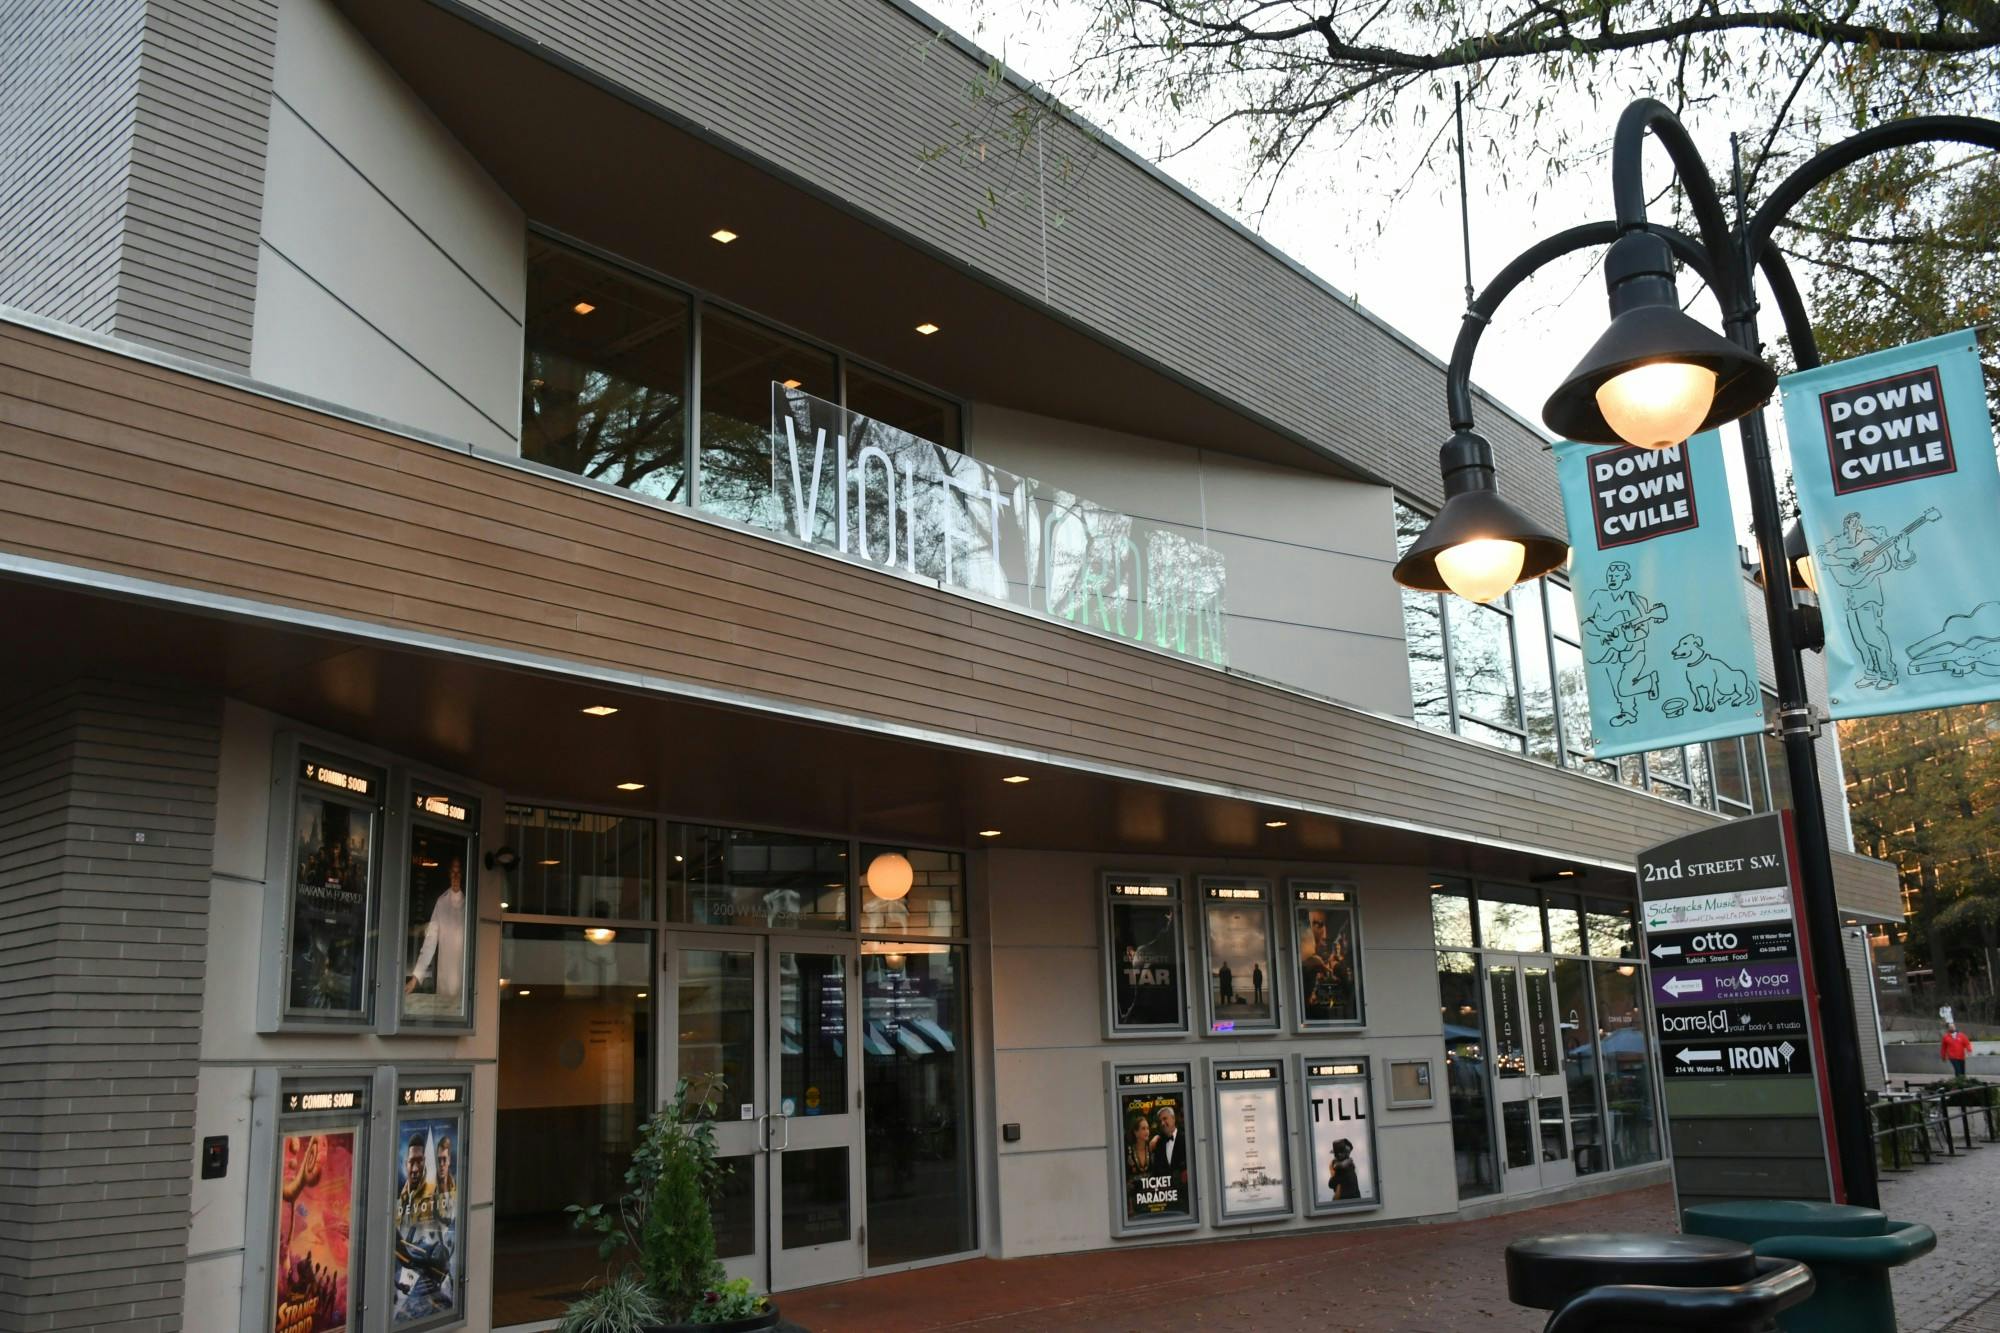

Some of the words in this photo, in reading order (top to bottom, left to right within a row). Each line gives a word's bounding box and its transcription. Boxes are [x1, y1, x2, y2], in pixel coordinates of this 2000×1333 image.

[1830, 382, 1933, 422] DOWN
[1835, 411, 1939, 451] TOWN
[1595, 445, 1681, 482] DOWN
[1840, 441, 1944, 480] CVILLE
[1599, 472, 1685, 508] TOWN
[1603, 499, 1689, 535] CVILLE
[318, 767, 347, 788] COMING
[347, 776, 367, 793] SOON
[425, 797, 449, 816] COMING
[449, 805, 465, 821] SOON
[1643, 859, 1684, 882] 2nd
[1688, 858, 1744, 877] STREET
[1750, 854, 1779, 869] S.W.
[1124, 886, 1139, 895] NOW
[1139, 886, 1168, 896] SHOWING
[1647, 900, 1702, 918] Sidetracks
[1704, 899, 1737, 912] Music
[1692, 932, 1738, 952] otto
[1732, 953, 1748, 961] Food
[1754, 974, 1789, 987] yoga
[1717, 988, 1790, 999] CHARLOTTESVILLE
[1729, 1024, 1746, 1032] your
[1728, 1046, 1780, 1069] IRON
[1134, 1074, 1148, 1084] NOW
[1149, 1073, 1178, 1083] SHOWING
[1229, 1070, 1244, 1079] NOW
[1244, 1069, 1271, 1079] SHOWING
[302, 1094, 332, 1110] COMING
[333, 1093, 354, 1108] SOON
[415, 1089, 439, 1103] COMING
[439, 1088, 456, 1102] SOON
[1311, 1097, 1365, 1122] TILL
[1141, 1176, 1172, 1189] TICKET
[1136, 1190, 1178, 1205] PARADISE
[277, 1296, 319, 1329] STRANGE
